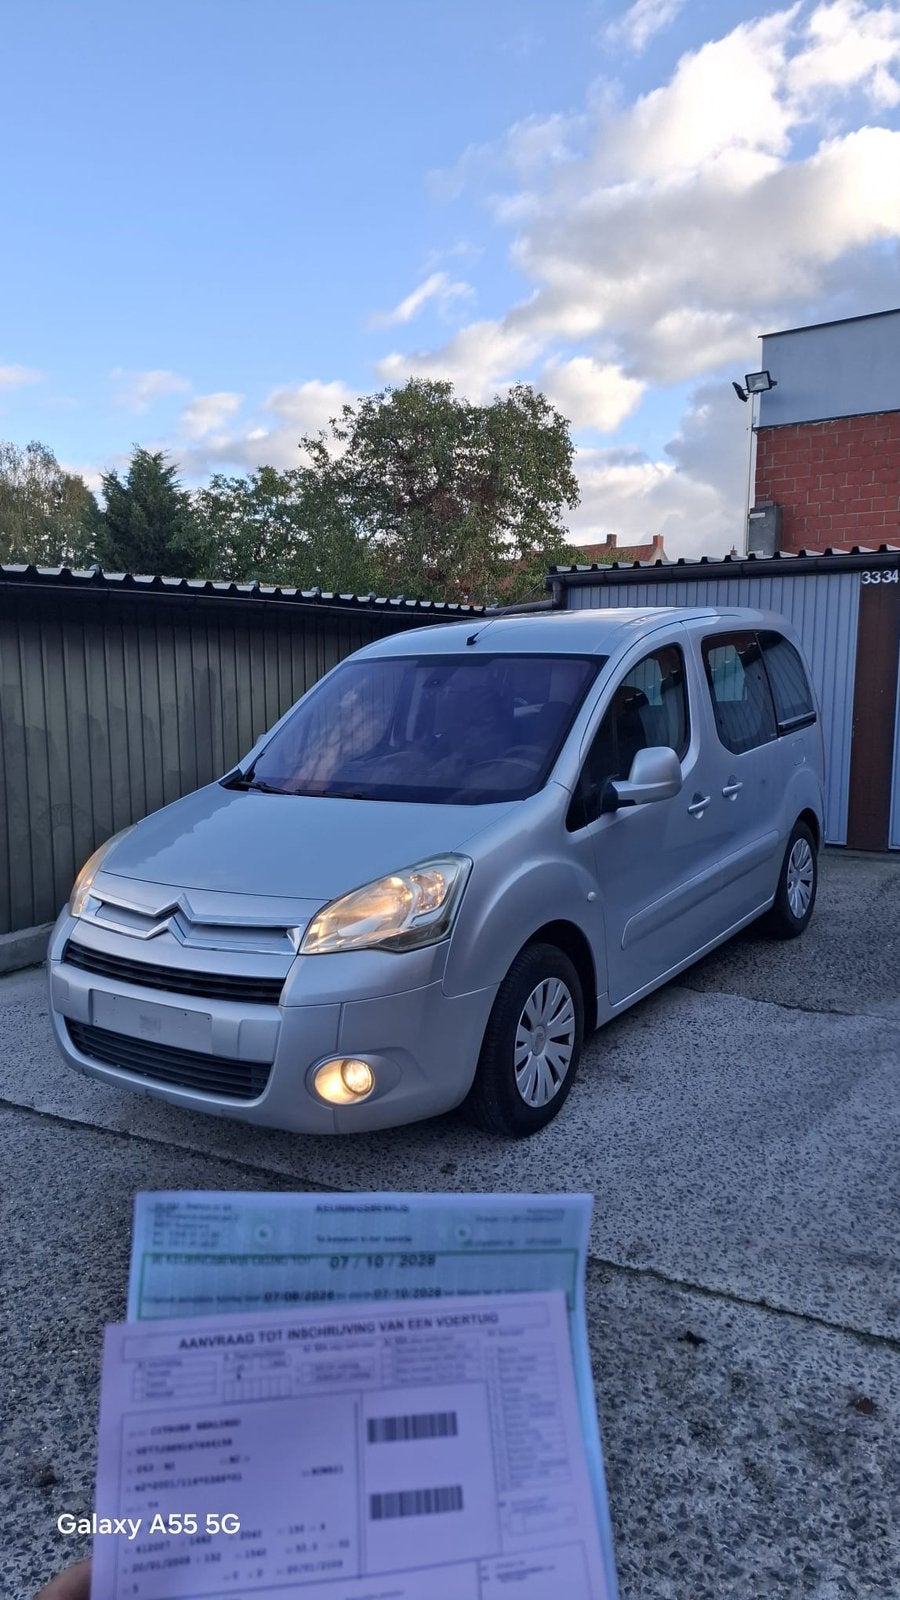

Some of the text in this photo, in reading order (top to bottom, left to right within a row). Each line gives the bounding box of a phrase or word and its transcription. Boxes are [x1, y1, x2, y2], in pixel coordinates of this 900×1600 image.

[178, 1312, 499, 1350] AANVRAAG TOT INSCHRIJVING VAN EEN VOERTUIG
